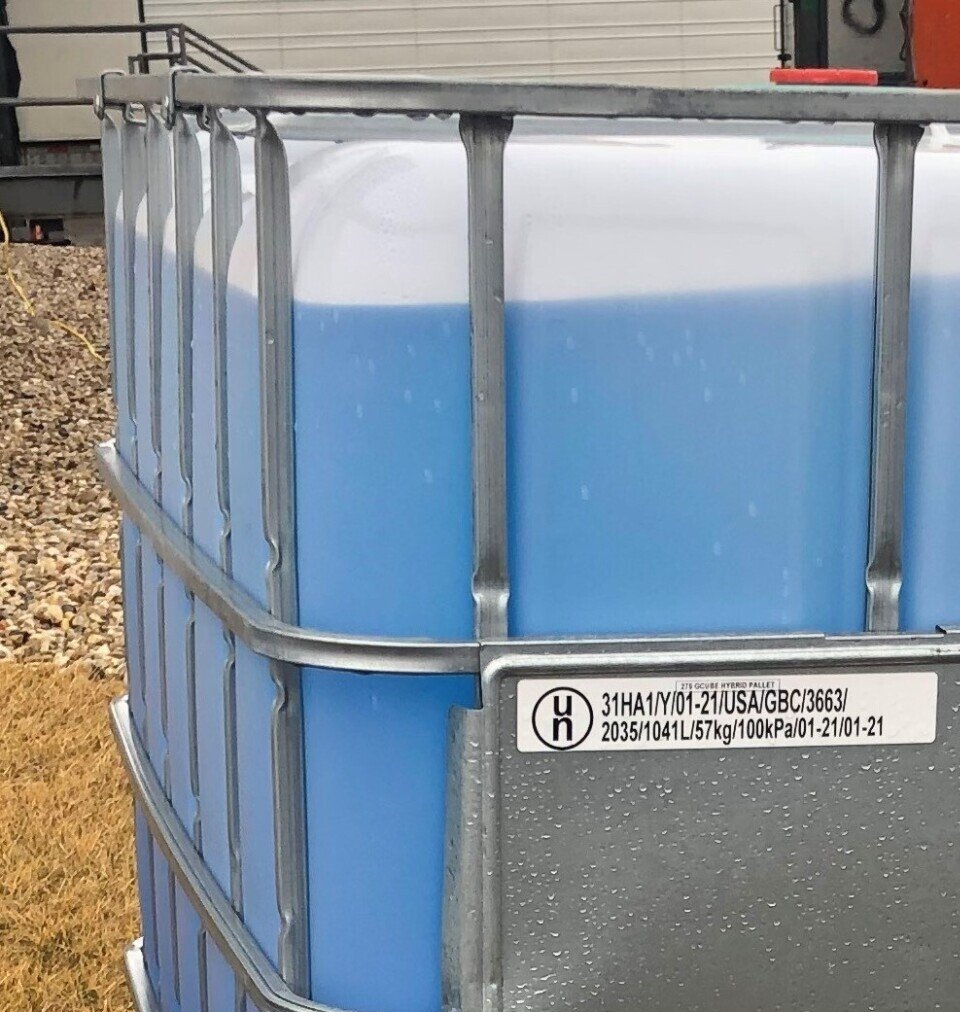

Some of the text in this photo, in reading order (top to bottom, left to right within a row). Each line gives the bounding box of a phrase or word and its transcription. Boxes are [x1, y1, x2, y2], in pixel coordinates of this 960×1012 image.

[694, 681, 719, 689] GCUBE
[720, 681, 747, 689] HYBRID
[748, 680, 775, 688] PALLET
[601, 688, 848, 717] 31HA1/Y/01-21/USA/GBC/3663/
[601, 716, 884, 744] 2035/1041L/57kg/100kPa/01-21/01-21
